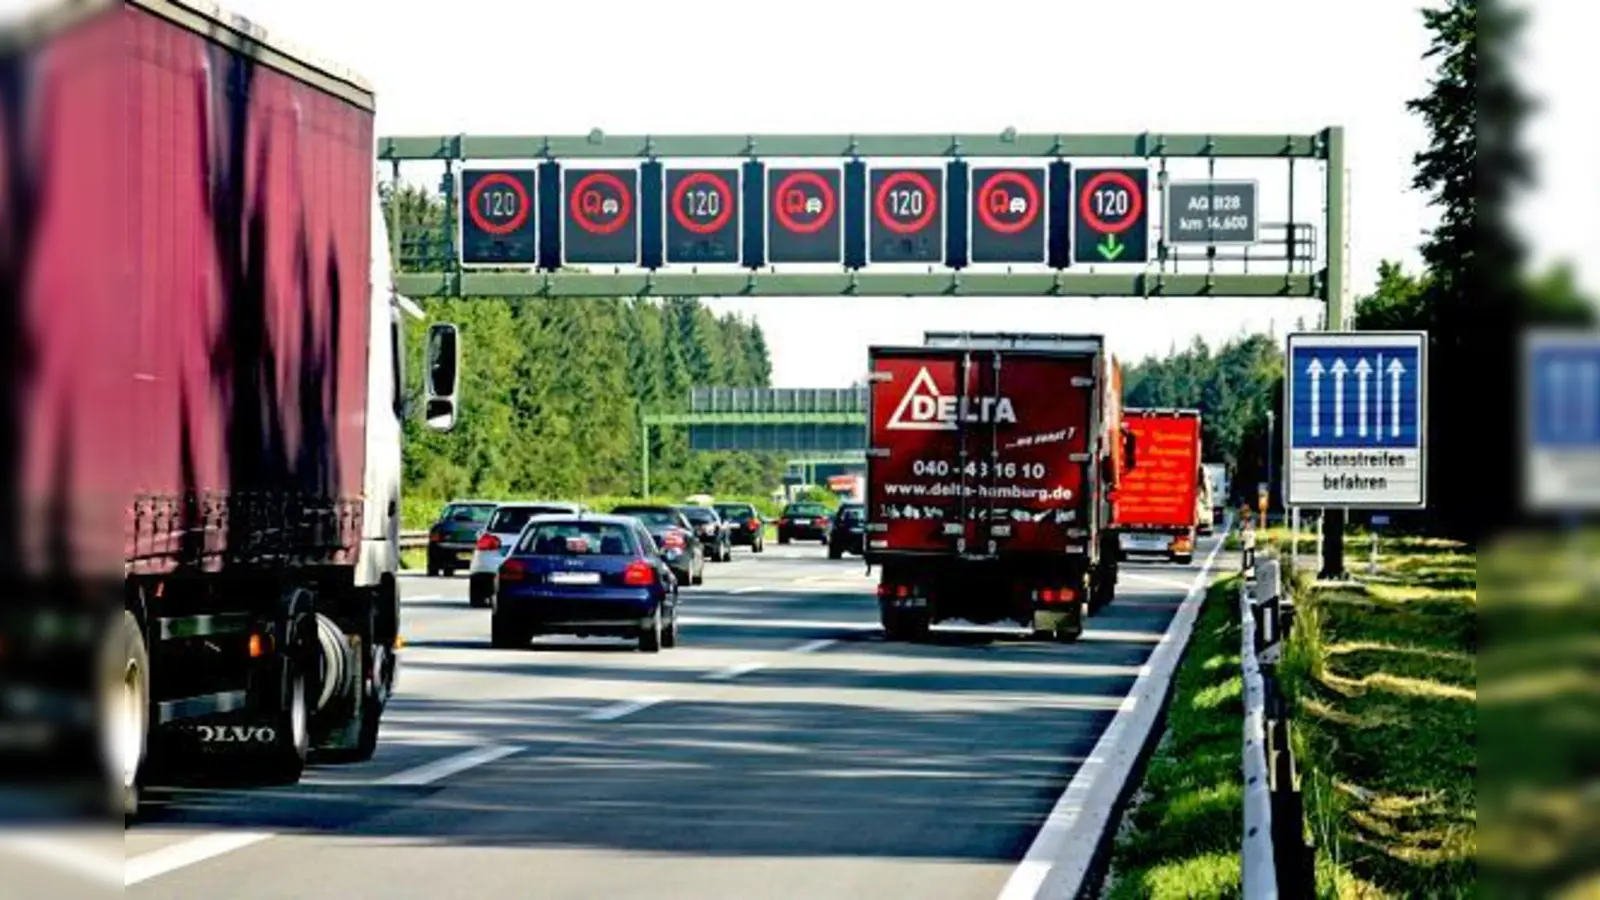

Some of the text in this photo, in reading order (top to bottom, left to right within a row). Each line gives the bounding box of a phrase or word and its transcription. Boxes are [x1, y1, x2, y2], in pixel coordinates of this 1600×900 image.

[482, 191, 515, 217] 120
[686, 190, 720, 216] 120
[889, 190, 923, 216] 120
[1094, 190, 1128, 216] 120
[1179, 216, 1204, 231] km
[910, 395, 1018, 424] DELTA
[913, 460, 948, 477] 040
[994, 462, 1016, 478] 16
[1022, 463, 1046, 479] 10
[1304, 450, 1406, 468] Seitenstreifen
[884, 482, 1073, 502] www.delta-hamburg.de
[1322, 473, 1388, 490] befahren
